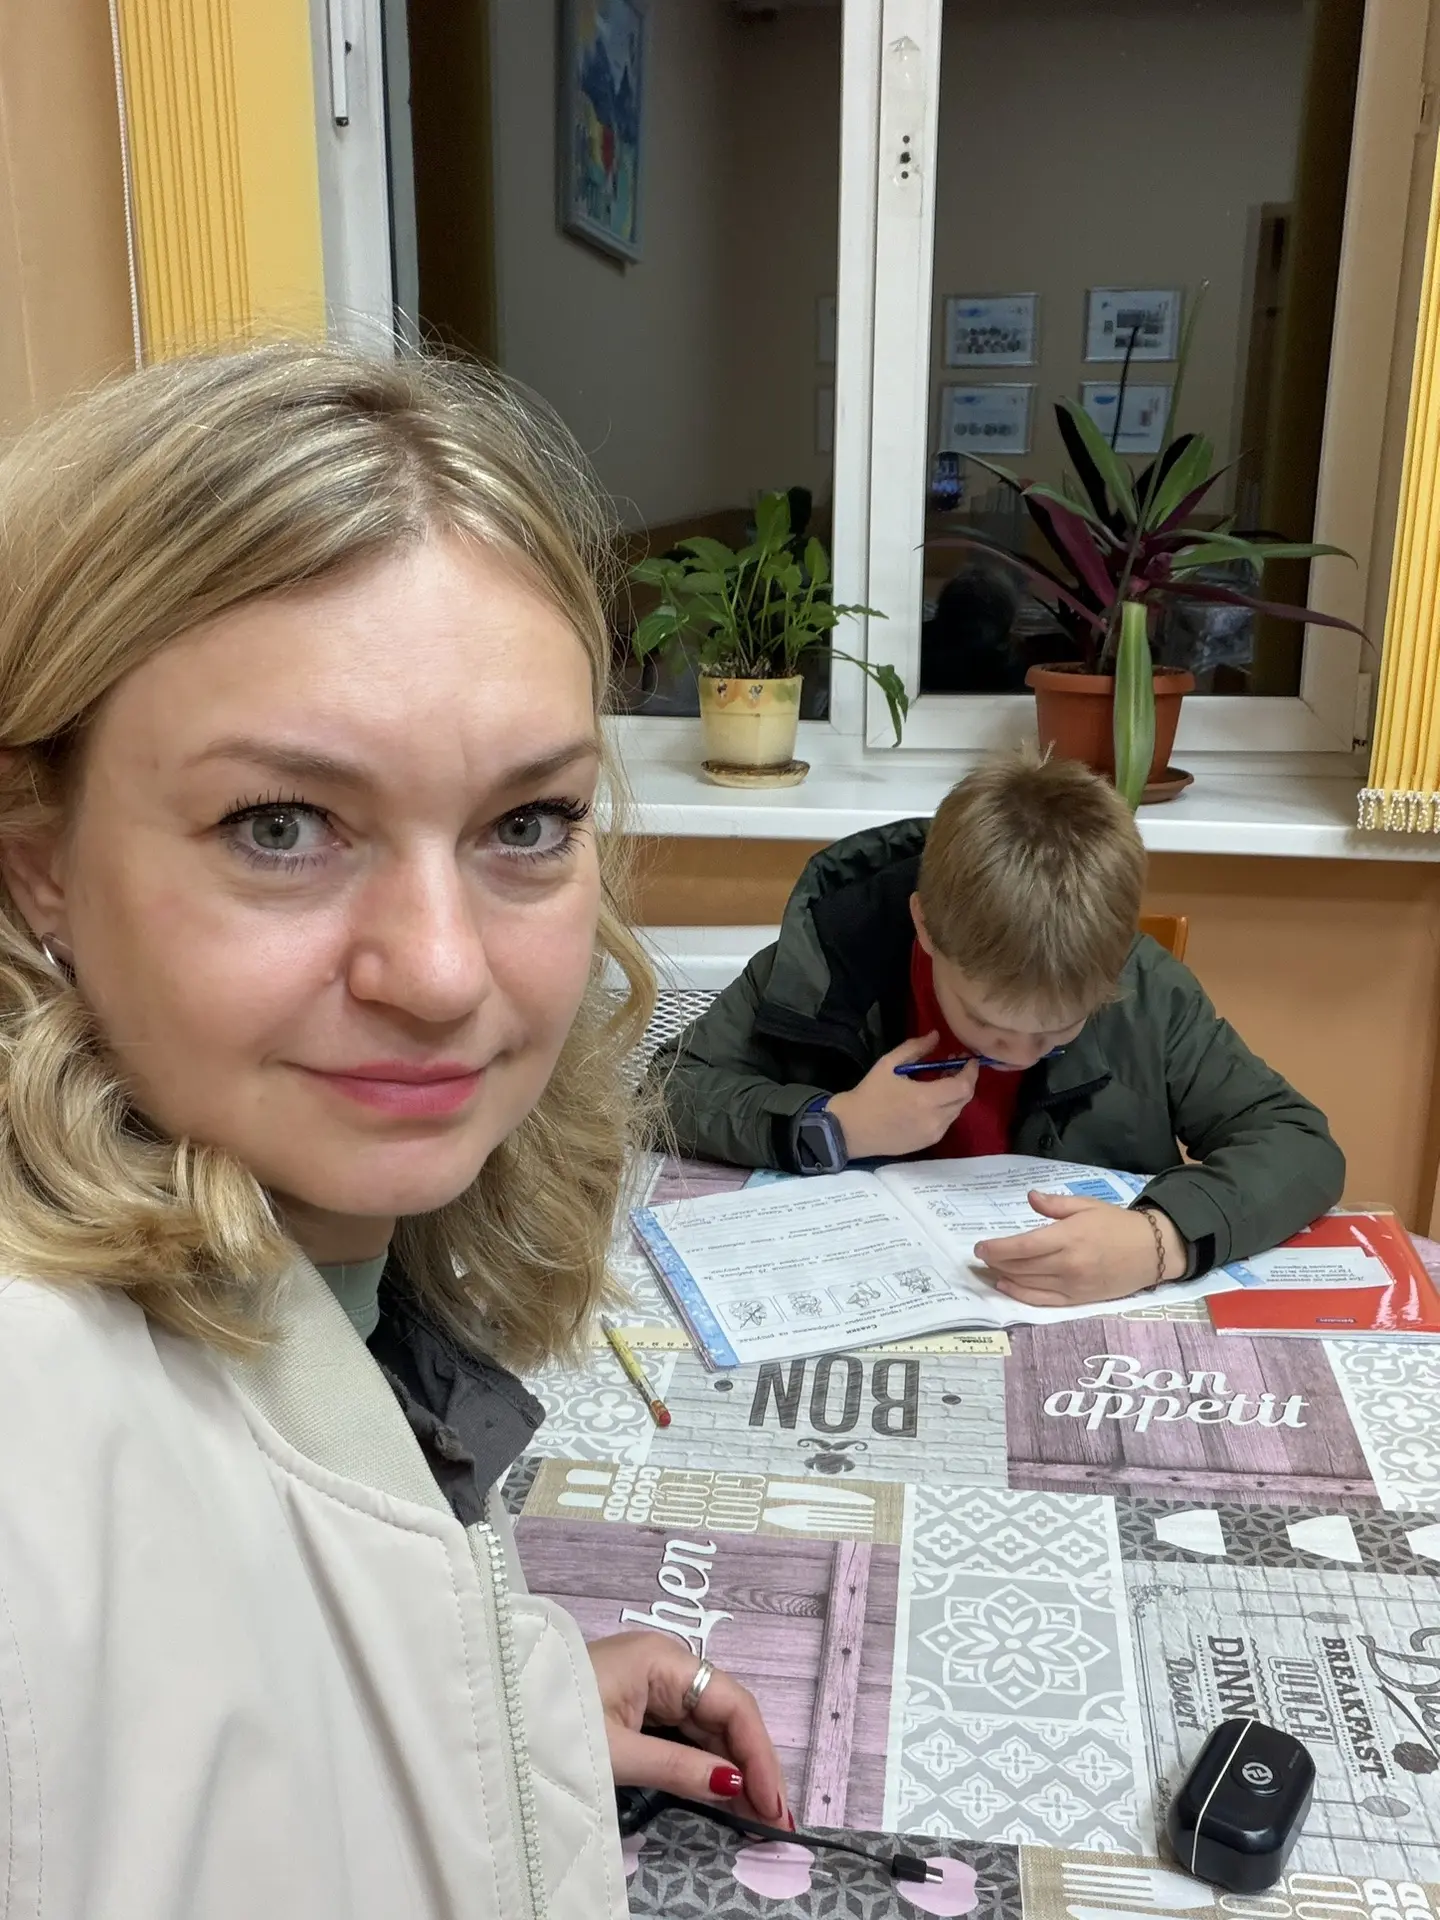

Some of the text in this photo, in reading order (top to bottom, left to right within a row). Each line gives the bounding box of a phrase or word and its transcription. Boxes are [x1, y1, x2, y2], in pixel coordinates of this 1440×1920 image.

[748, 1354, 921, 1439] BON
[1077, 1354, 1232, 1395] Bon
[1043, 1387, 1310, 1433] appetit
[625, 1465, 661, 1523] GOOD
[650, 1467, 716, 1529] FOOD
[704, 1472, 766, 1533] GOOD
[1165, 1656, 1201, 1731] Dessert
[1207, 1635, 1260, 1721] DINN
[1269, 1656, 1338, 1744] LUNCH
[1321, 1636, 1388, 1781] BREAKFAST
